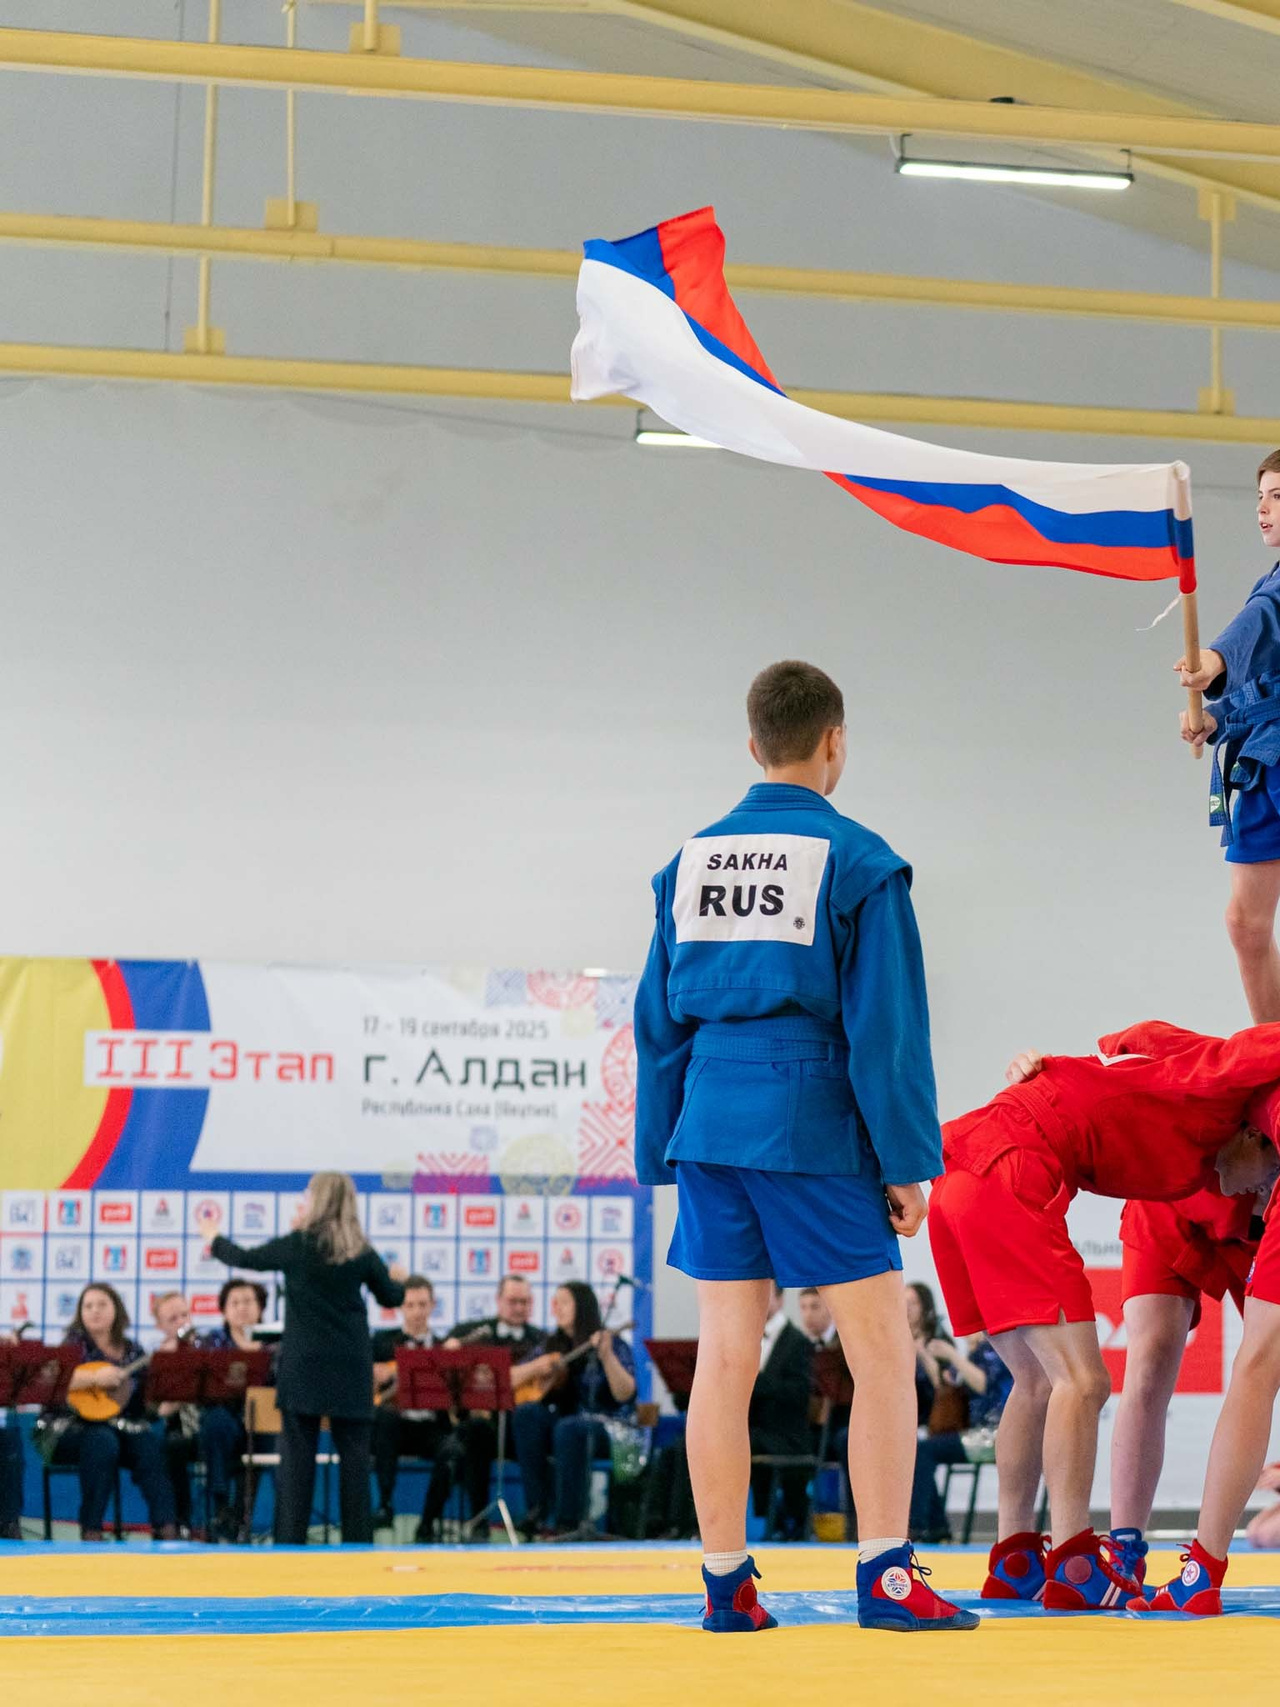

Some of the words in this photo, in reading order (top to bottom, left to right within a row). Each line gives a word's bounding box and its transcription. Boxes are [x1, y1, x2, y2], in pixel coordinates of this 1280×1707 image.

[707, 853, 788, 871] SAKHA
[699, 884, 785, 917] RUS
[363, 1016, 379, 1034] 17
[399, 1017, 417, 1036] 19
[422, 1018, 500, 1041] сентября
[505, 1019, 548, 1040] 2025
[96, 1038, 192, 1079] III
[209, 1040, 334, 1081] Этап
[364, 1054, 399, 1085] г.
[415, 1048, 587, 1092] Алдан
[362, 1100, 451, 1119] Республика
